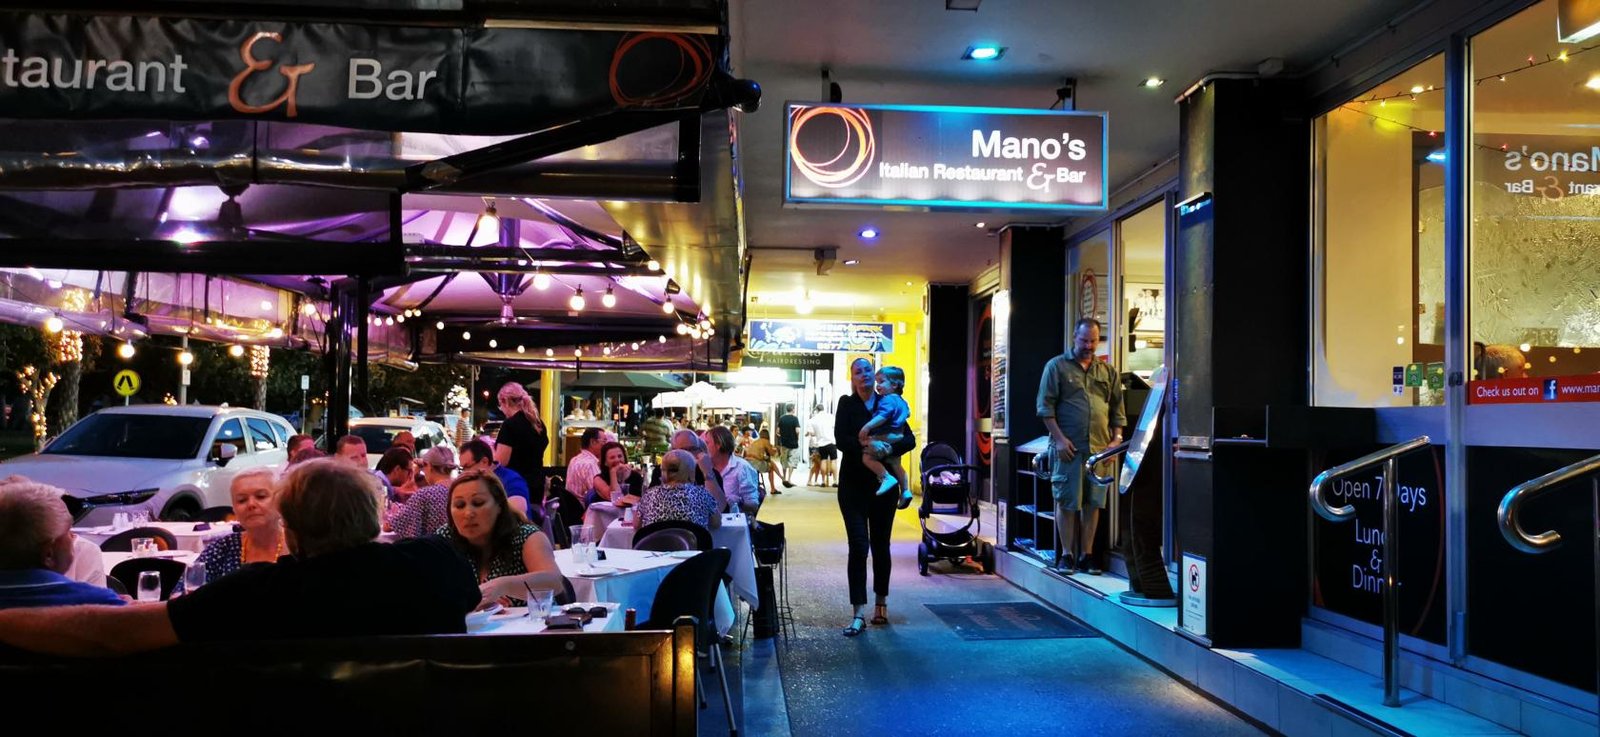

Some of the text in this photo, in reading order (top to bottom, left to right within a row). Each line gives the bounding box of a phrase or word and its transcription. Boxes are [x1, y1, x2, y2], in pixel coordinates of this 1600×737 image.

[1, 31, 437, 117] taurant & Bar
[971, 129, 1087, 161] Mano's
[879, 162, 1087, 193] Italian Restaurant & Bar
[766, 358, 821, 366] HAIRDRESSING
[1476, 385, 1500, 398] Check
[1501, 389, 1511, 397] us
[1512, 387, 1527, 397] out
[1528, 387, 1539, 396] on
[1332, 476, 1426, 512] Open 7 ays
[1355, 518, 1385, 546] Lun
[1370, 548, 1383, 574] &
